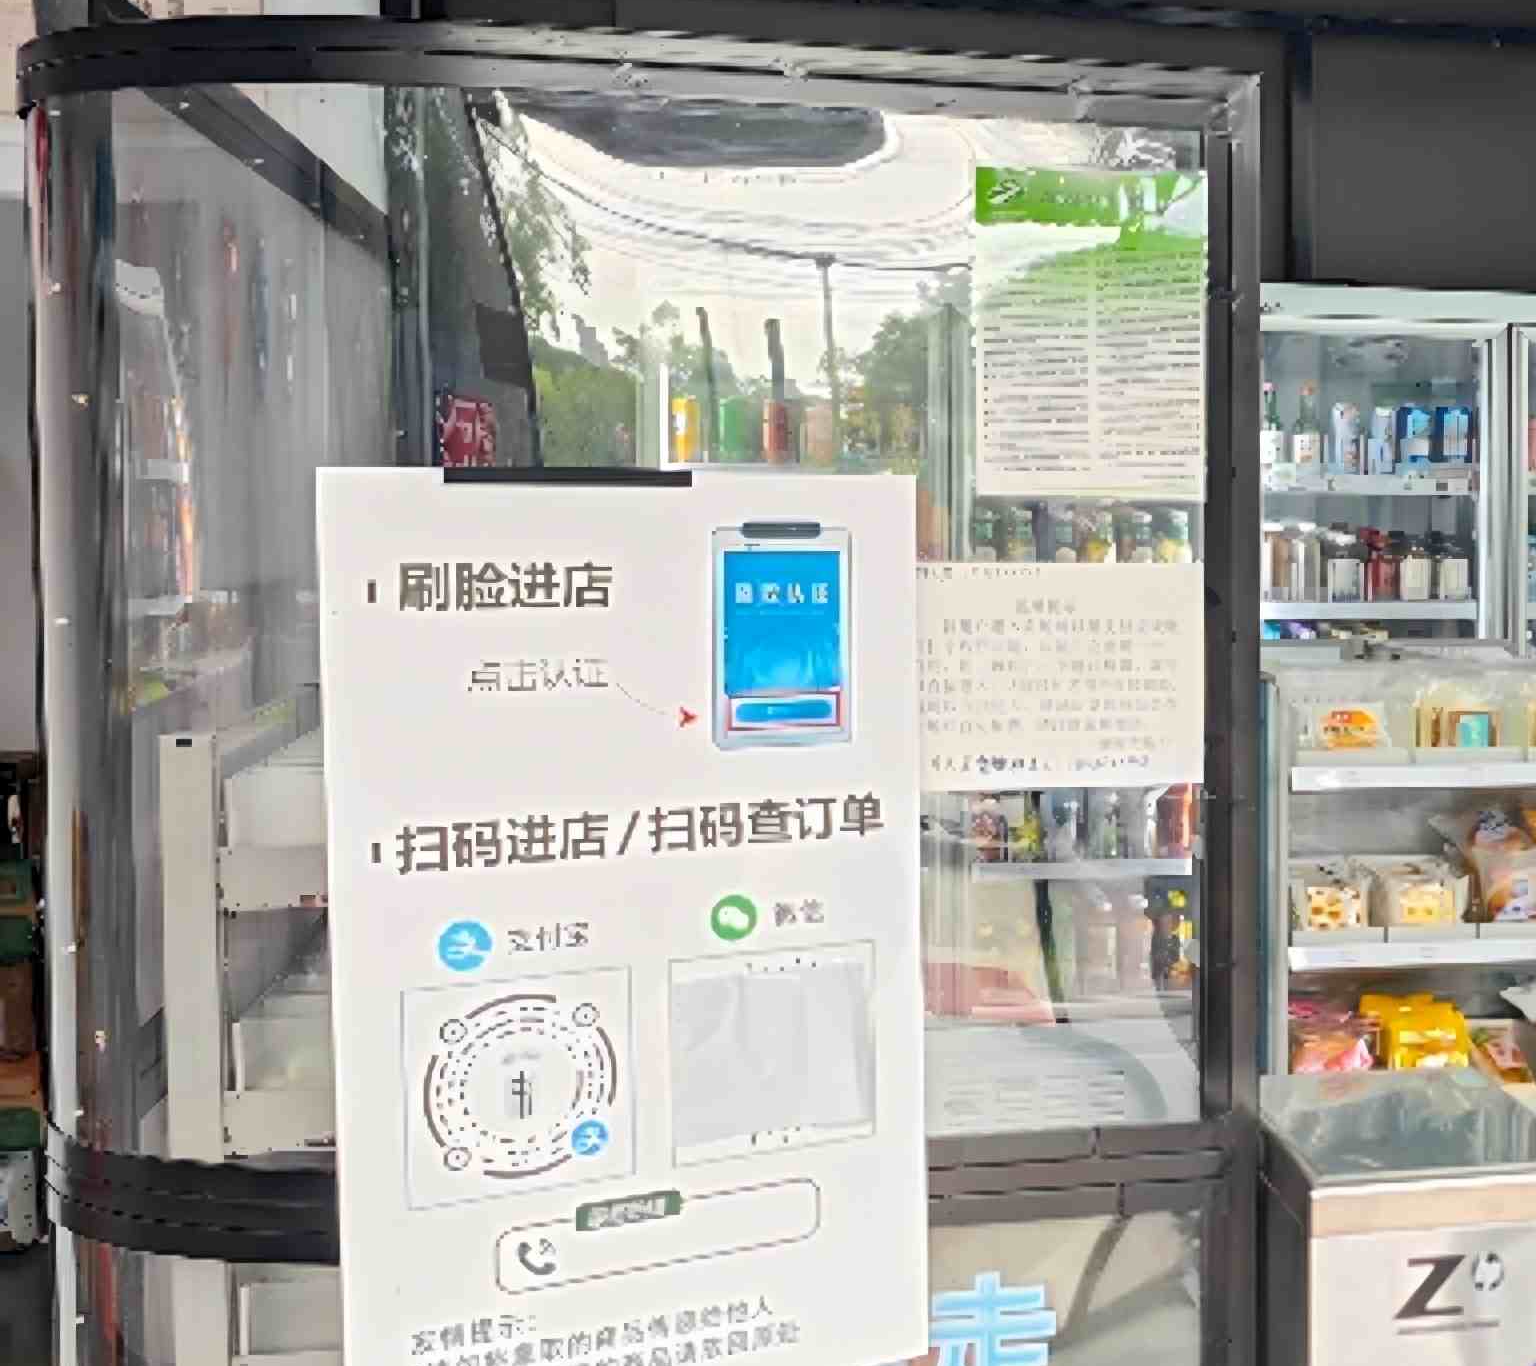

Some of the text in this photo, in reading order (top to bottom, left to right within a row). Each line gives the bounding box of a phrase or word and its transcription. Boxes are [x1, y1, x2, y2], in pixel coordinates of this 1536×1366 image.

[398, 561, 614, 613] 刷脸进店
[396, 792, 885, 876] 扫码进店/扫码查订单
